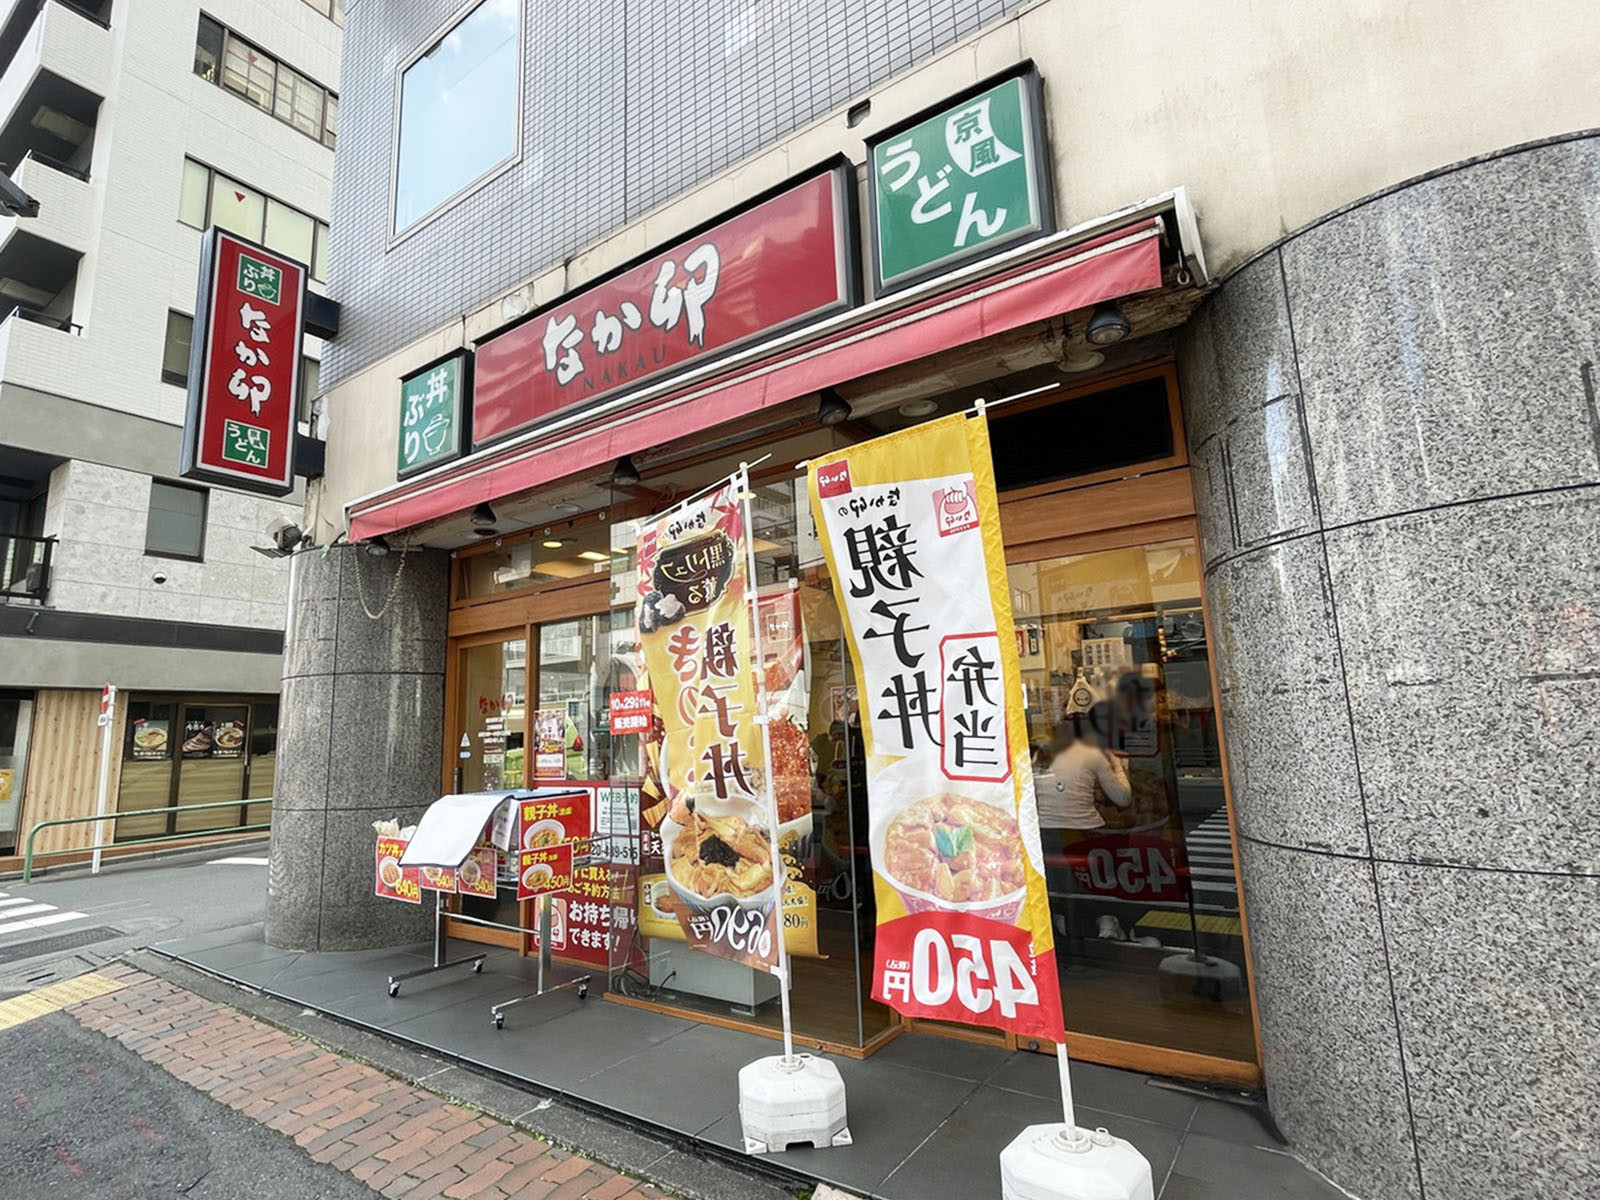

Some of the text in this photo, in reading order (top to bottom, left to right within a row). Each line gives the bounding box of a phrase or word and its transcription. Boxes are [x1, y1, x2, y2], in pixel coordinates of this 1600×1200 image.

[952, 108, 1001, 173] 京風
[880, 138, 1007, 247] うどん
[541, 242, 721, 386] なか卯
[227, 302, 272, 418] なか卯
[582, 346, 668, 390] NAKAU
[227, 423, 262, 465] うどん
[523, 802, 559, 821] 親子丼
